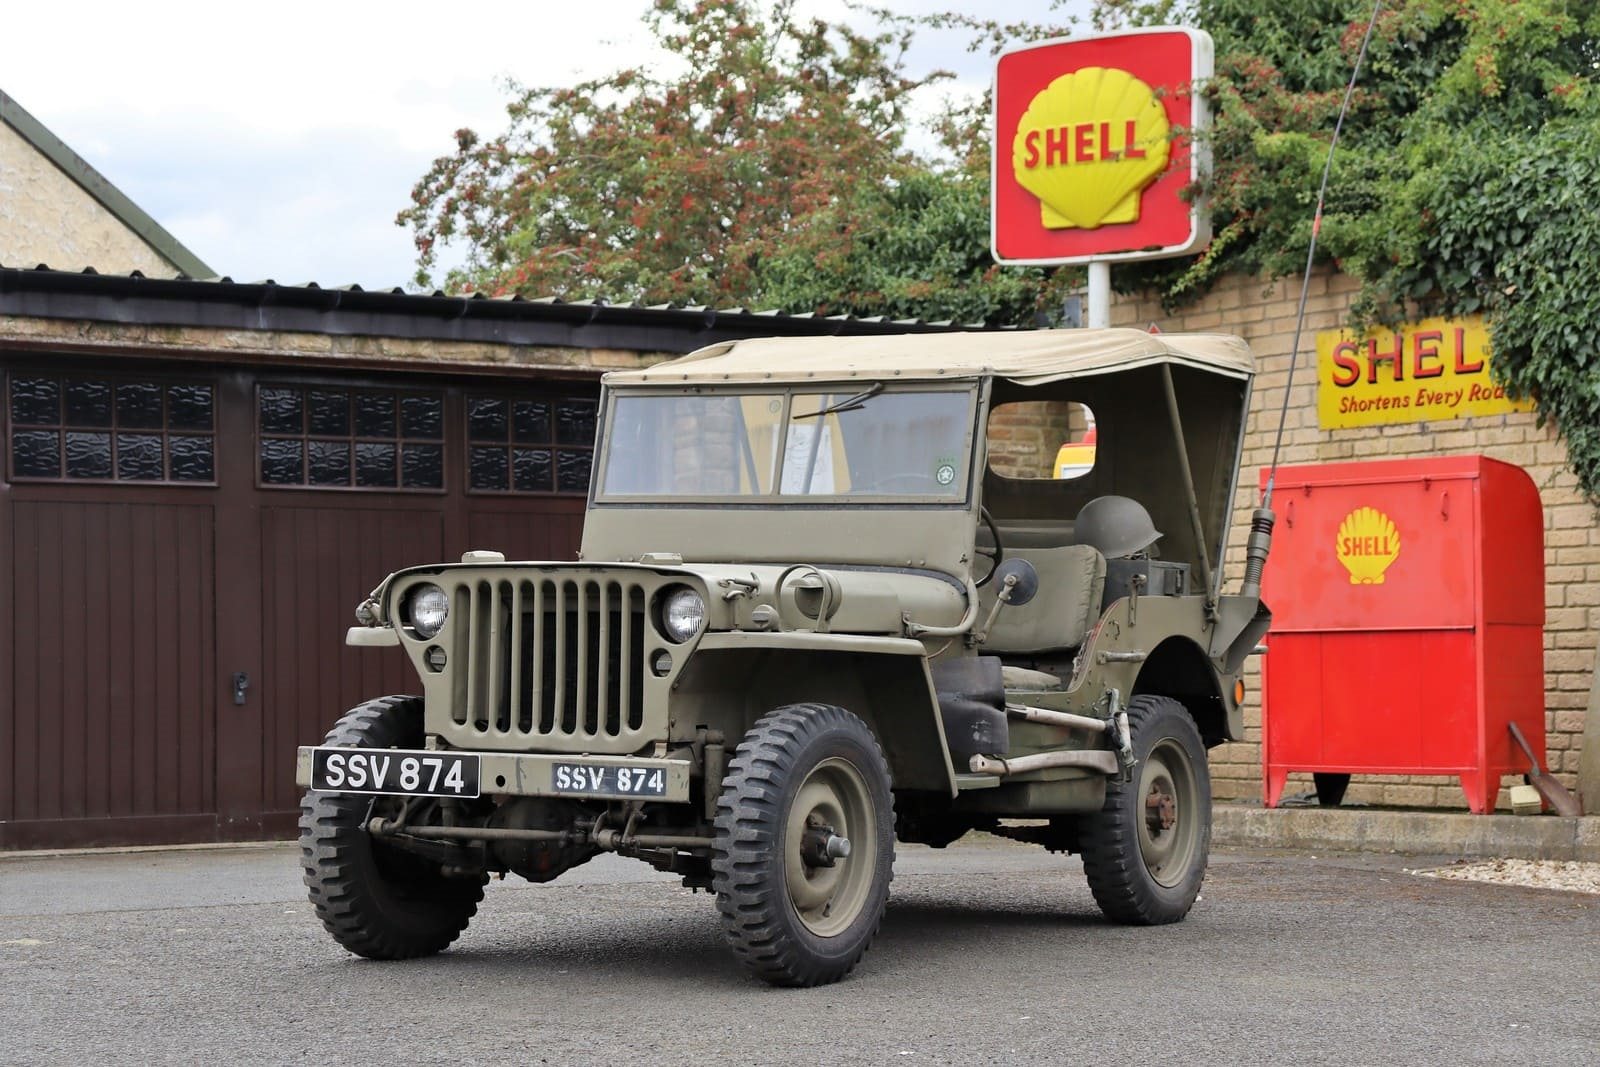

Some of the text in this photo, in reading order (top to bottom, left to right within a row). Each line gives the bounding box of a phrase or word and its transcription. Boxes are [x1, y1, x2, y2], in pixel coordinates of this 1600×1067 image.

[1024, 120, 1146, 169] SHELL
[1332, 328, 1485, 387] SHEL
[1339, 382, 1505, 414] Shortens Every Roa
[1343, 535, 1392, 557] SHELL
[325, 753, 464, 793] SSV 874
[556, 766, 664, 792] SSV 874
